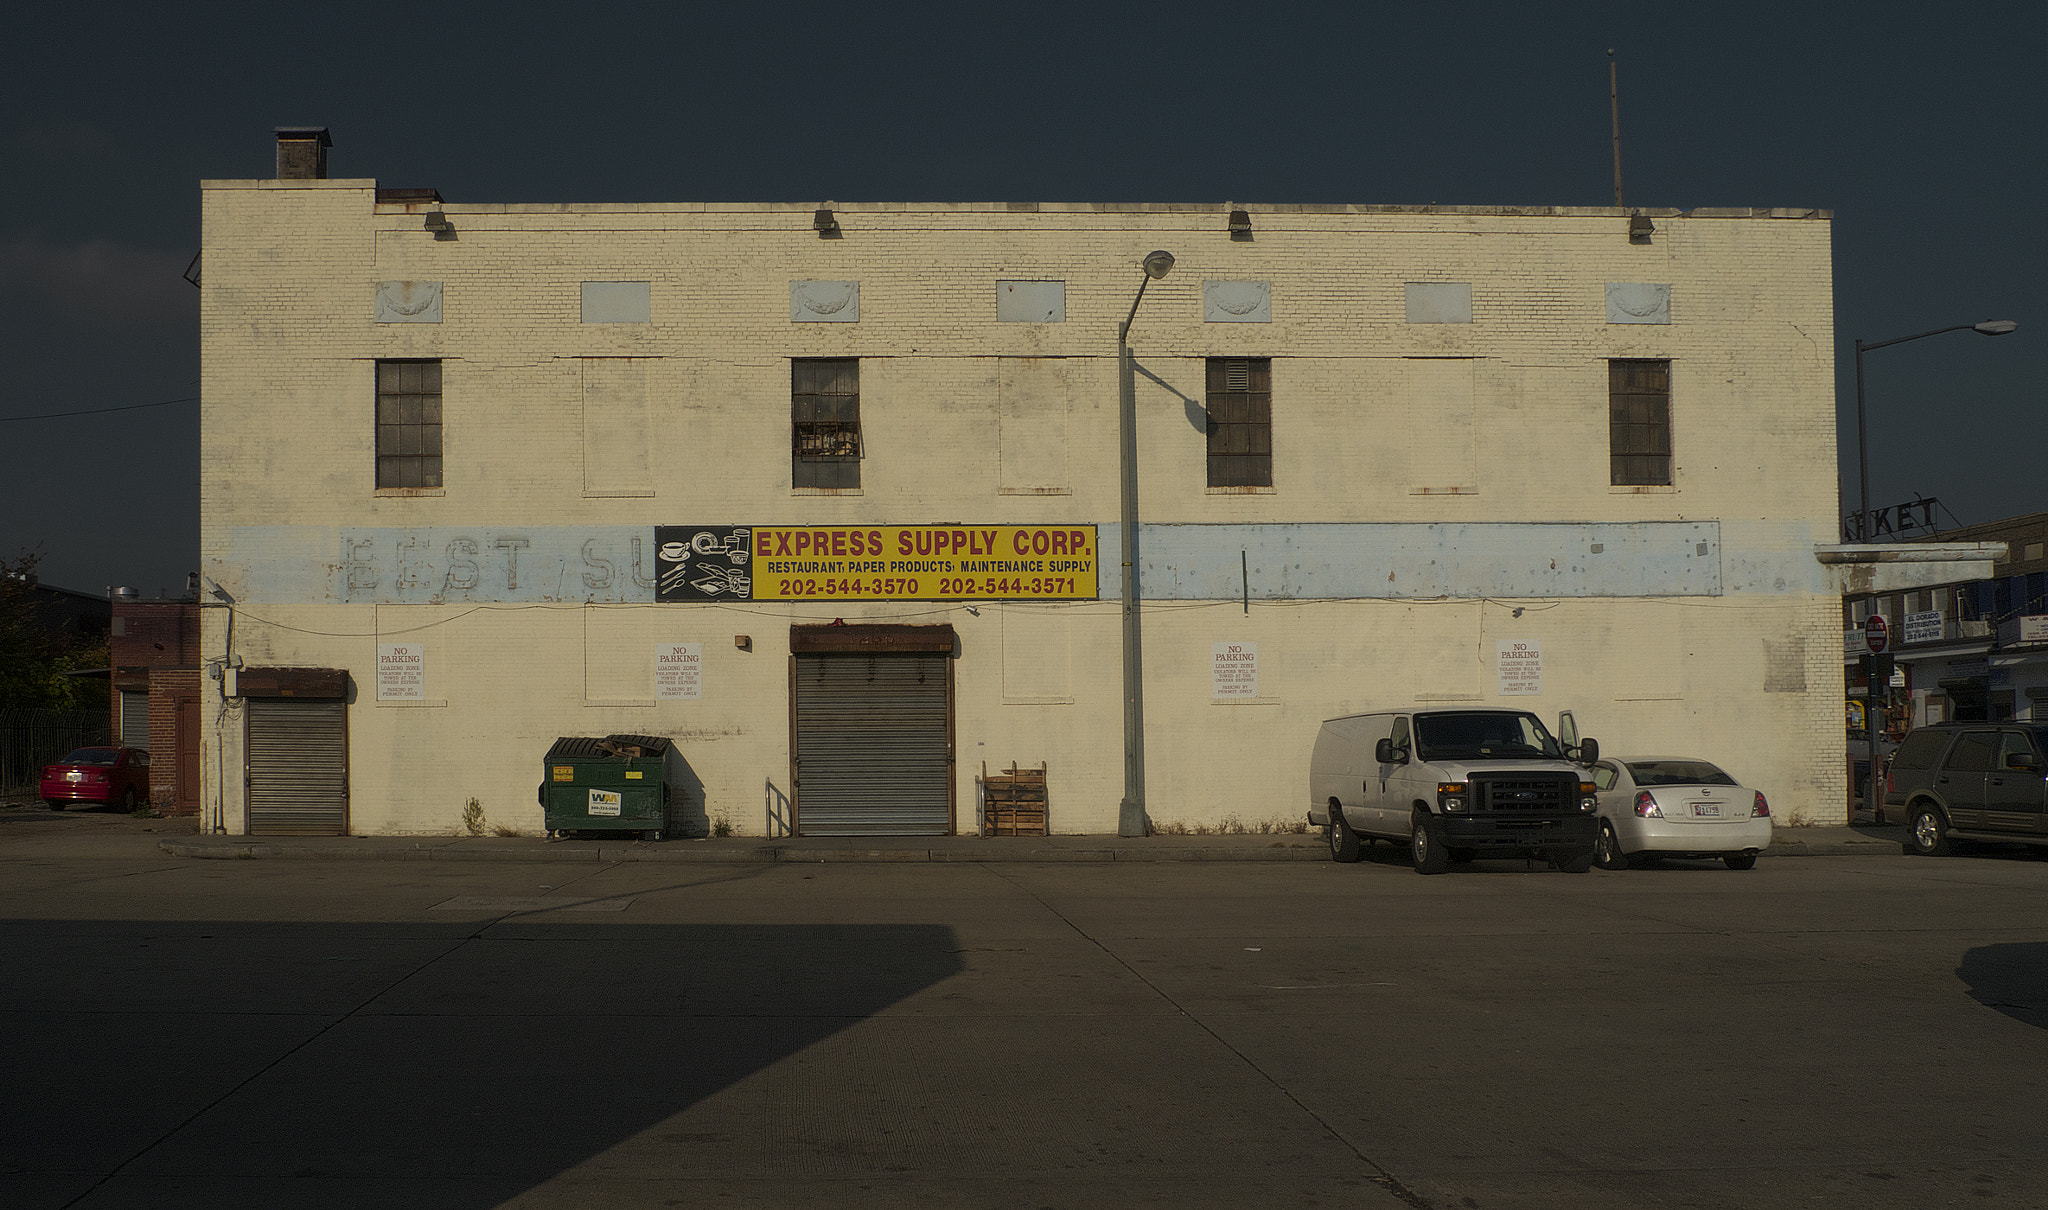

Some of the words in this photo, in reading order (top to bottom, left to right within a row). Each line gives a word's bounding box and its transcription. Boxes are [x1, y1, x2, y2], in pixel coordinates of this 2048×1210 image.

[757, 531, 883, 556] EXPRESS
[898, 530, 998, 556] SUPPLY
[1013, 530, 1091, 556] CORP.
[768, 562, 845, 573] RESTAURANT,
[849, 561, 885, 573] PAPER
[891, 561, 955, 573] PRODUCTS,
[961, 561, 1043, 572] MAINTENANCE
[1049, 561, 1091, 572] SUPPLY
[780, 579, 919, 596] 202-544-3570
[940, 578, 1075, 594] 202-544-3571
